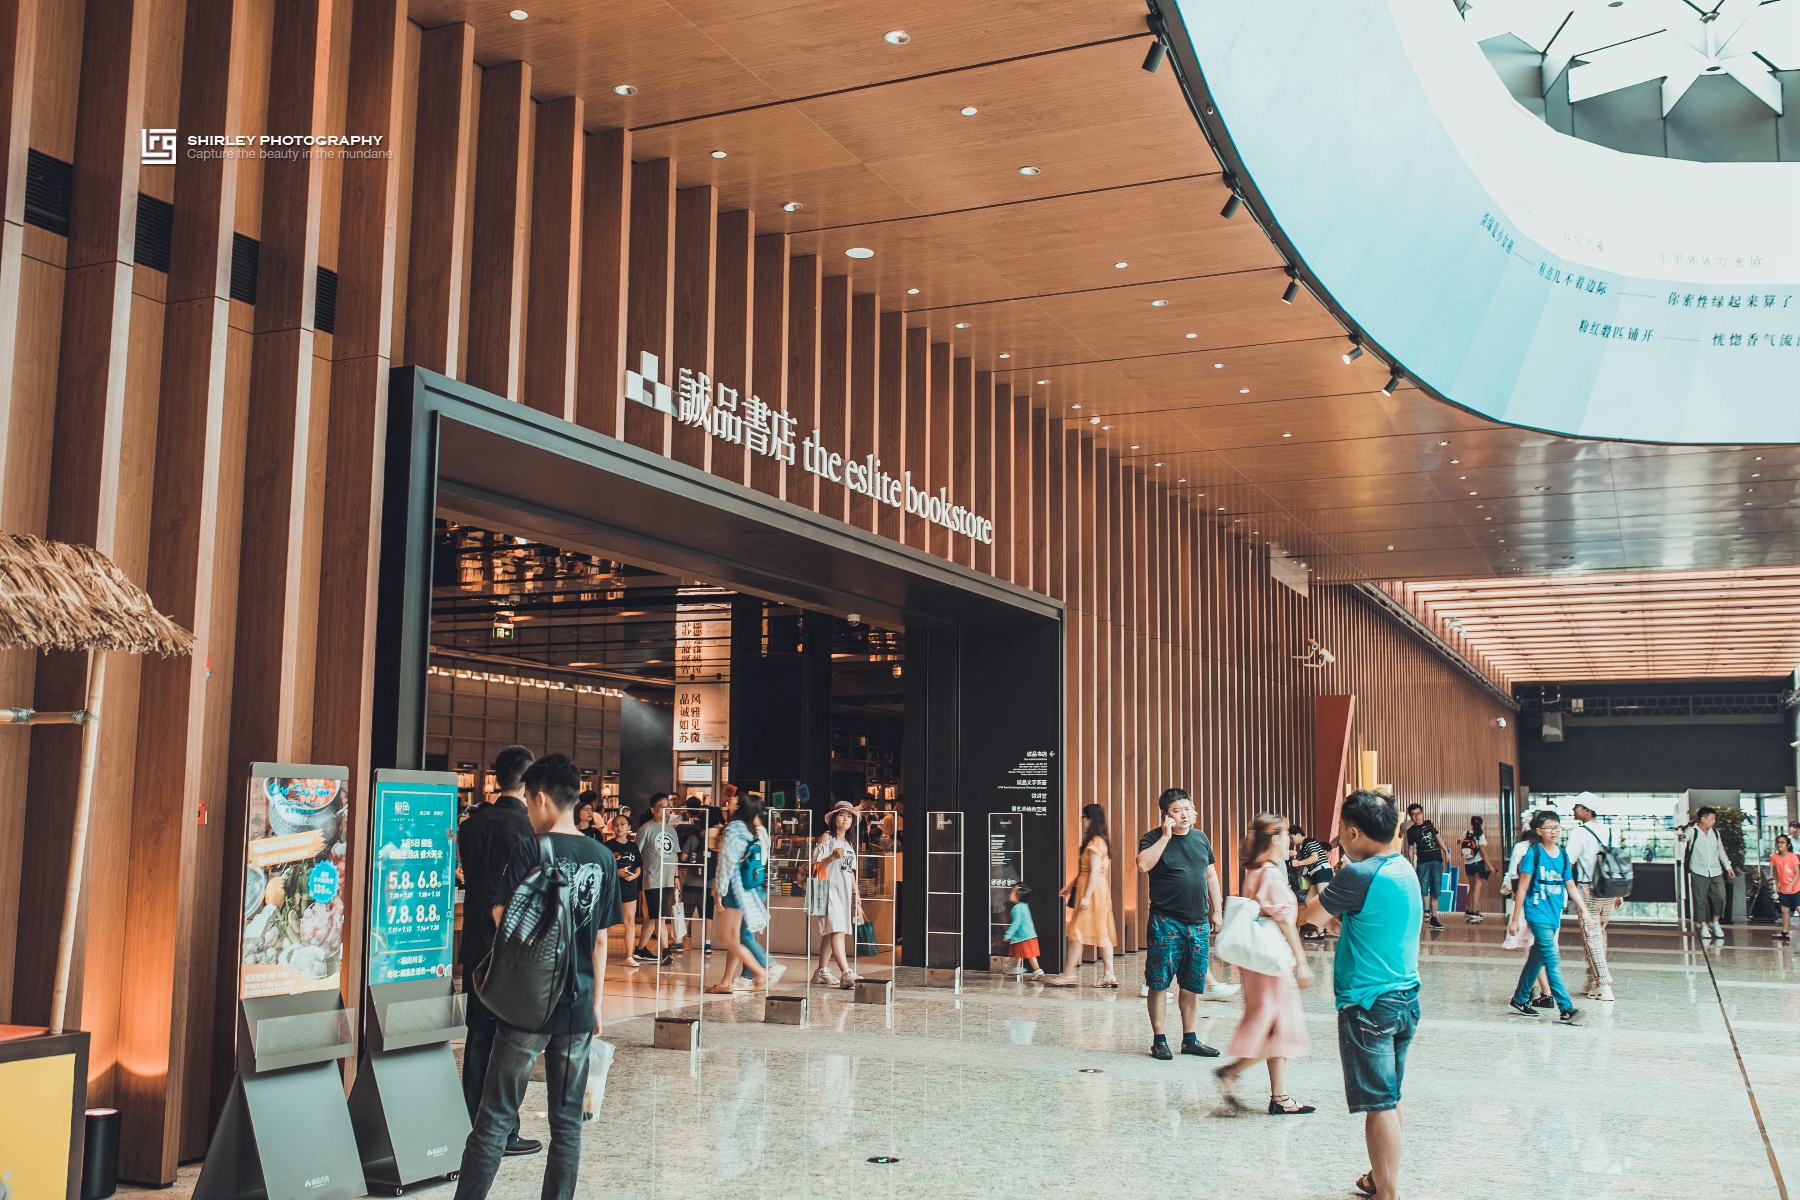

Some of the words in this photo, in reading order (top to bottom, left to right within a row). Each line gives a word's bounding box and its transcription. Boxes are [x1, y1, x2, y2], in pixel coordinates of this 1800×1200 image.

[1539, 261, 1608, 295] 有点儿不着边际
[1667, 291, 1793, 308] 你索性绿起来算了
[678, 367, 797, 466] 誠品書店
[802, 428, 843, 483] the
[844, 454, 902, 508] eslite
[904, 471, 993, 545] bookstore
